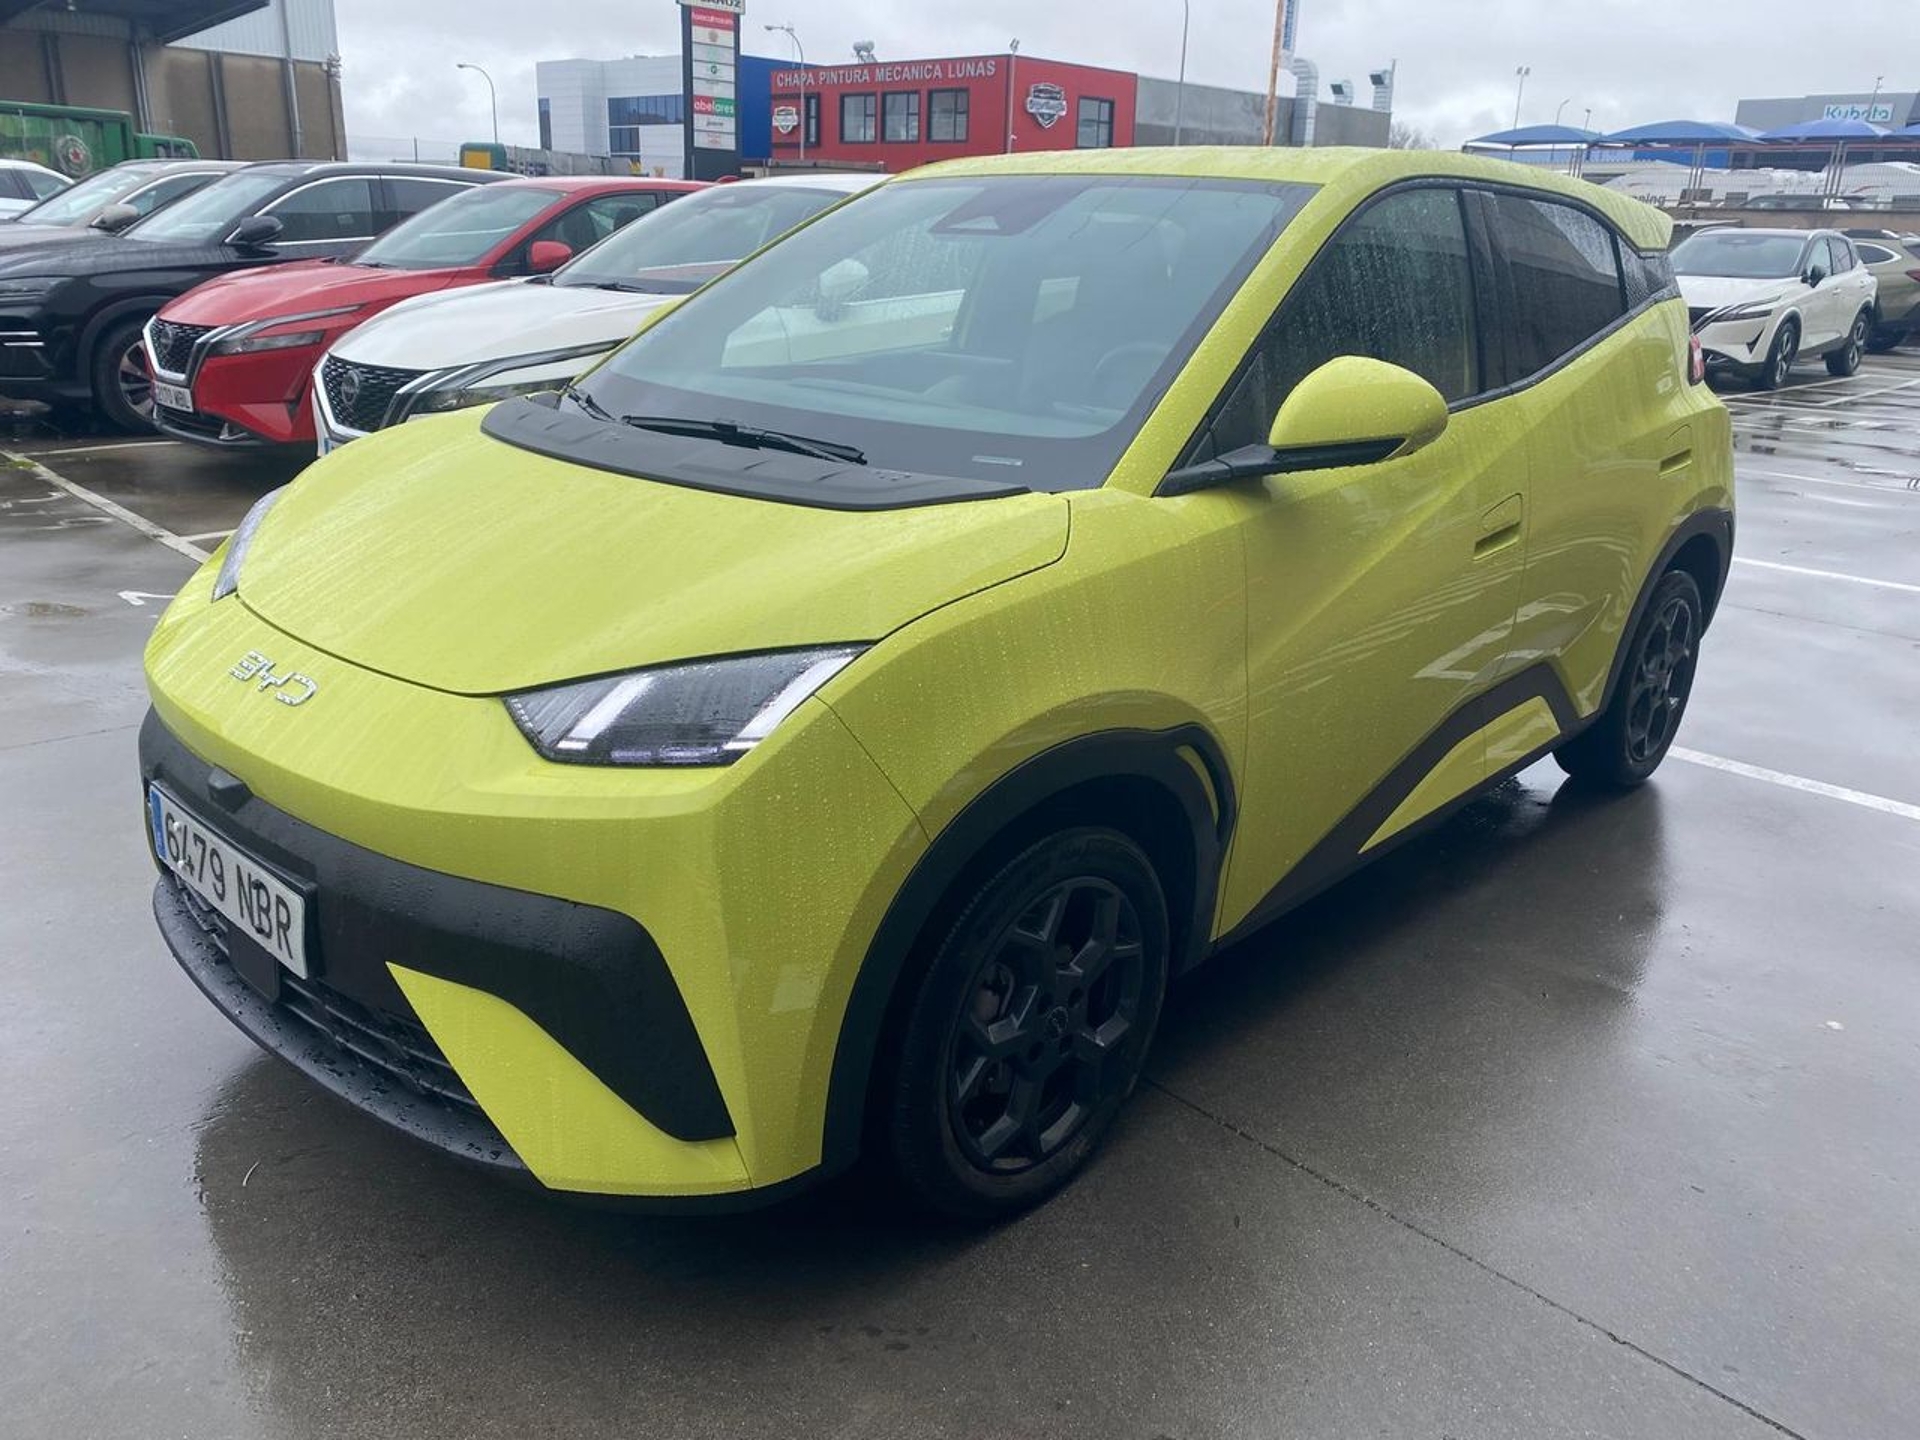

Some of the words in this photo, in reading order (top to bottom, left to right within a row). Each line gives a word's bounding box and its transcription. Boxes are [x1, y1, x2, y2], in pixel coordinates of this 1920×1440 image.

[776, 72, 815, 87] CHAPA
[818, 68, 870, 85] PINTURA
[874, 63, 943, 82] MECANICA
[947, 60, 997, 79] LUNAS
[1825, 105, 1890, 120] Kubota
[228, 650, 319, 707] BYD
[165, 812, 226, 902] 6479
[236, 863, 293, 959] NBR
